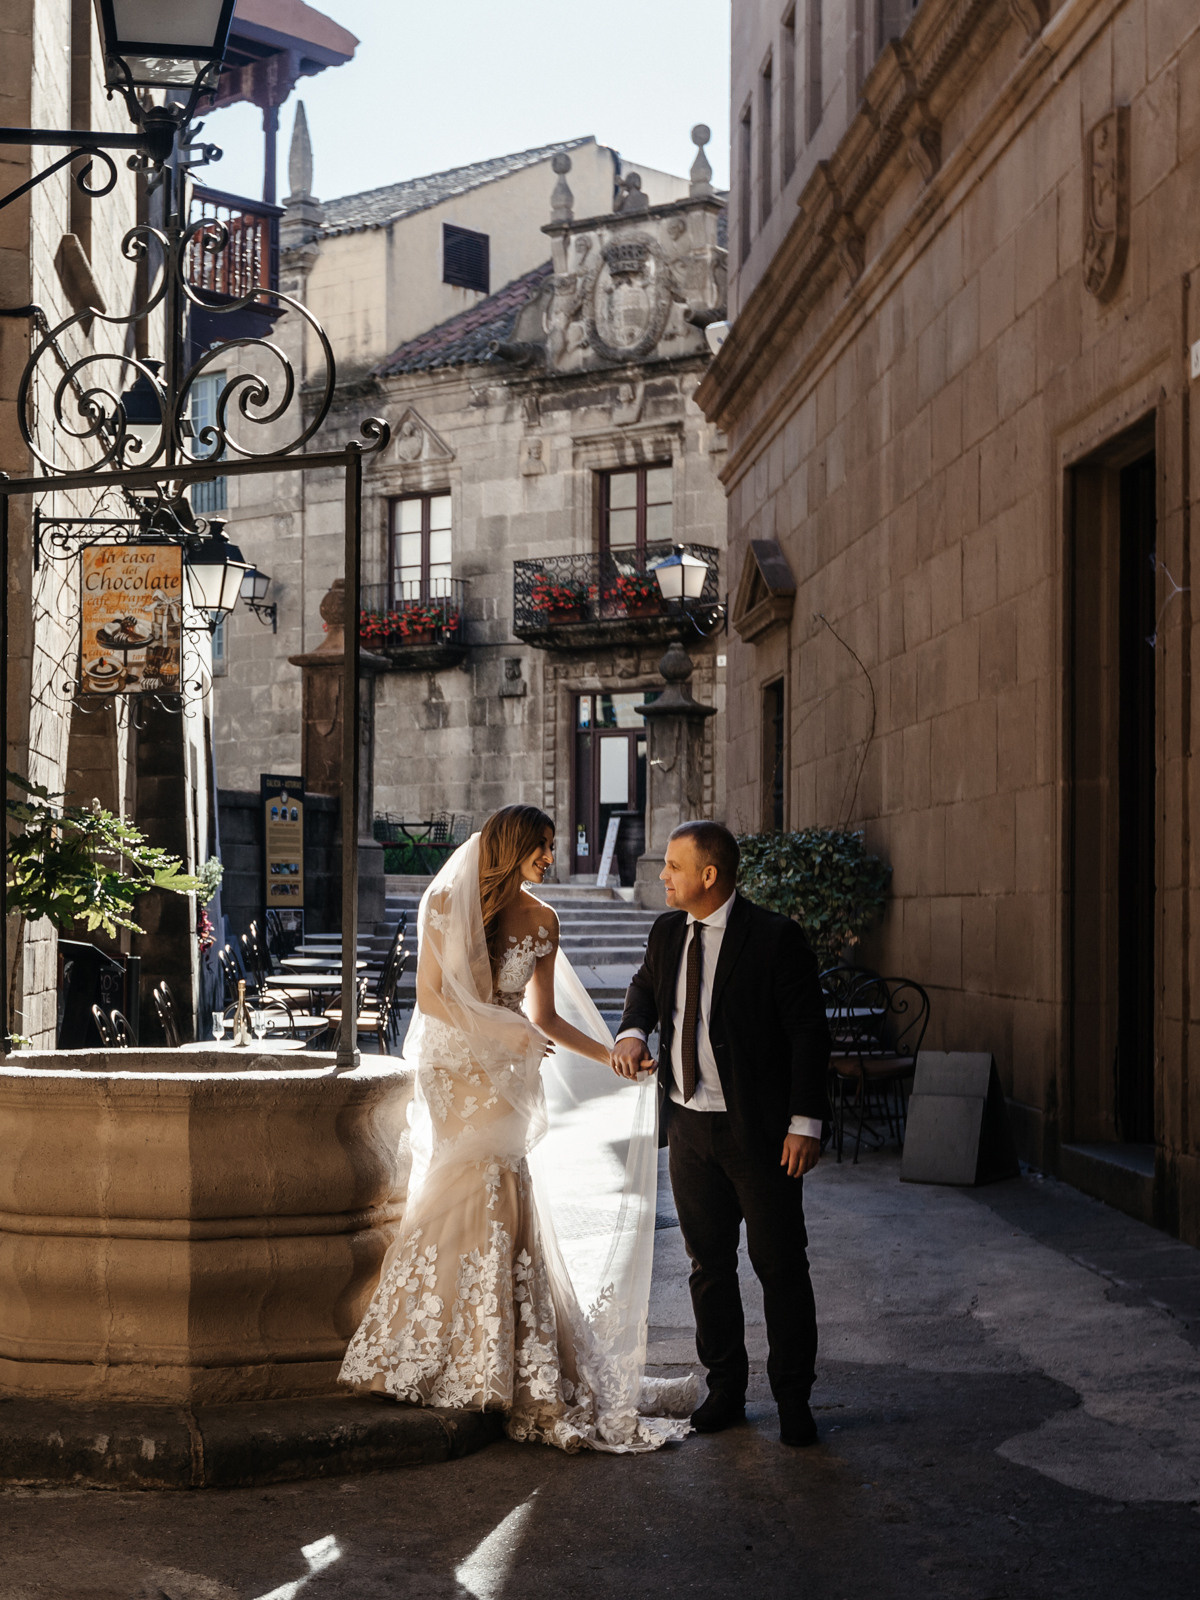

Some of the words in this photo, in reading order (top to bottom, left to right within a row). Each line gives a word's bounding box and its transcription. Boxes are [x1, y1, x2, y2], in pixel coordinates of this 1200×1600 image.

[102, 548, 116, 564] la
[122, 552, 156, 564] casa
[122, 565, 141, 575] del
[85, 566, 180, 591] Chocolate
